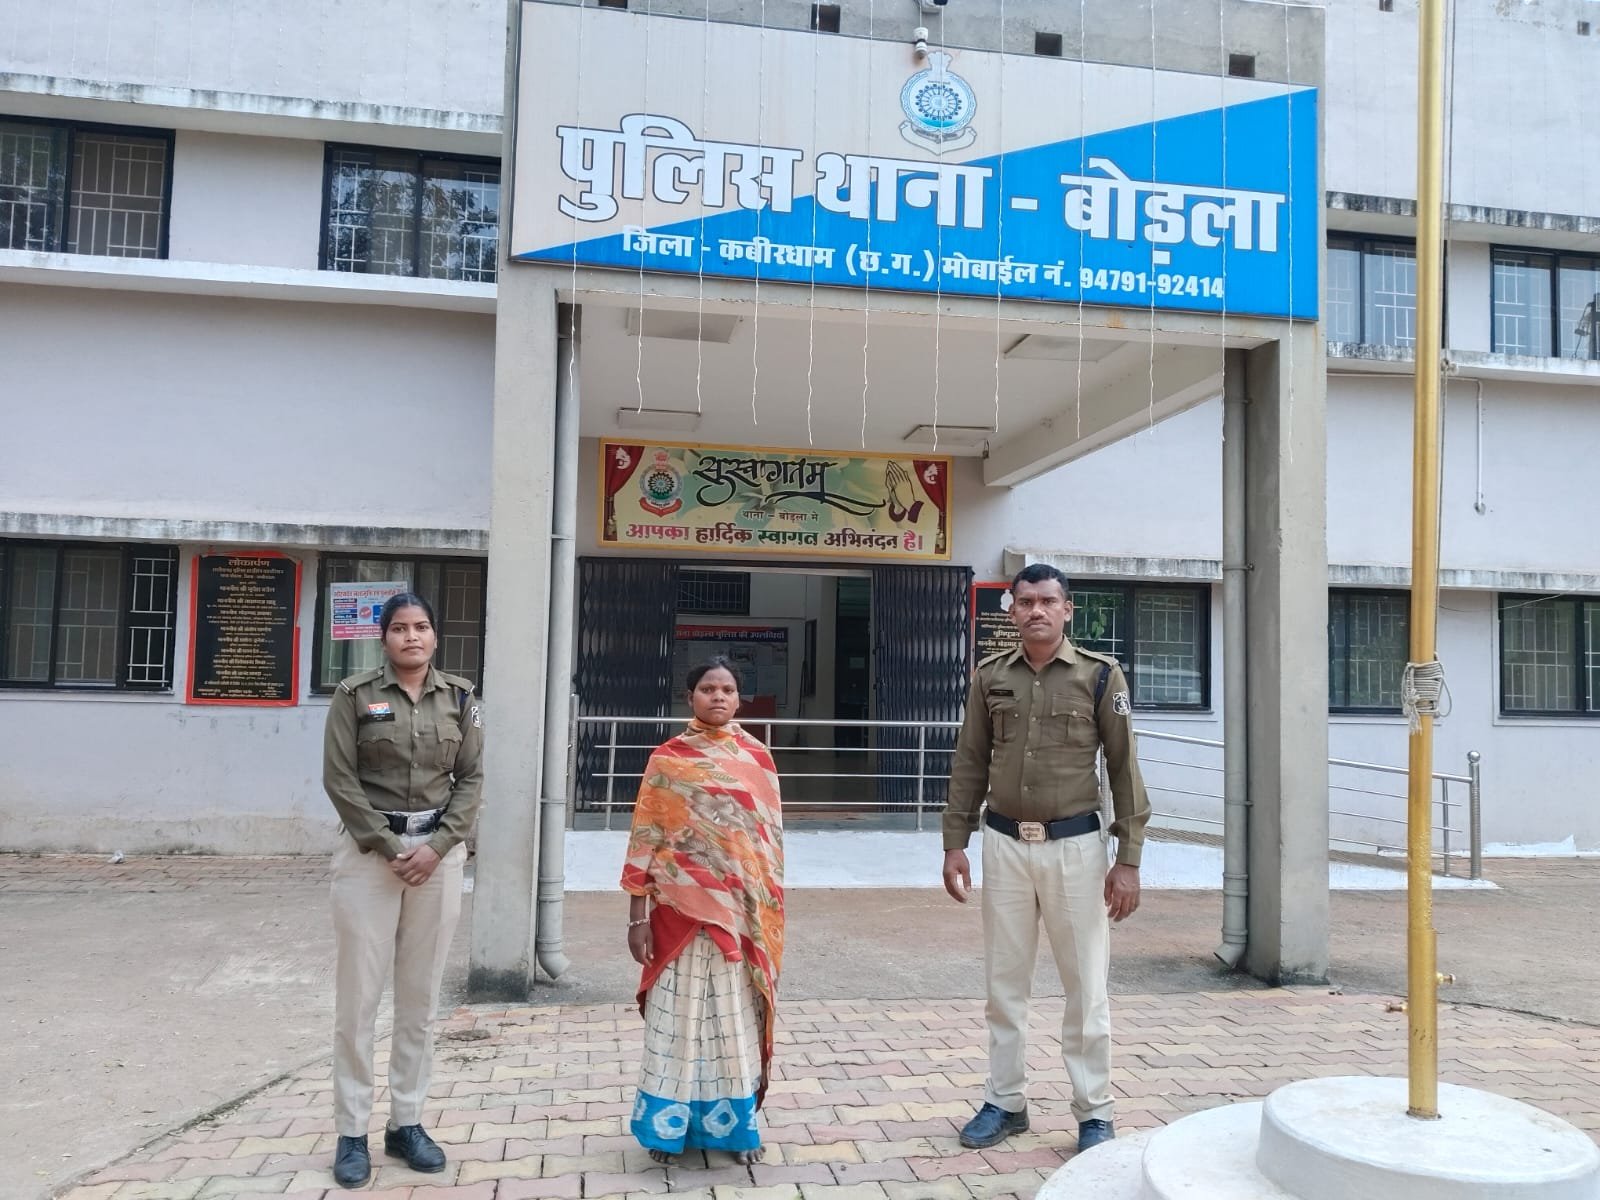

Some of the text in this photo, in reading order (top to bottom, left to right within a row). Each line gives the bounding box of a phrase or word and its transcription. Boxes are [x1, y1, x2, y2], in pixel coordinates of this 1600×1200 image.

[556, 112, 1286, 265] पुलिस थाना - बोड़ला
[622, 225, 695, 257] जिला
[719, 237, 836, 269] कबीरधाम
[845, 243, 935, 282] (छ.ग.)
[941, 252, 1039, 285] मोबाईल
[1043, 260, 1072, 288] नं.
[1080, 267, 1224, 298] 94791-92414
[626, 523, 690, 540] आपका
[695, 521, 753, 544] हार्दिक
[758, 529, 819, 545] स्वागत
[824, 527, 899, 550] अभिनंदन
